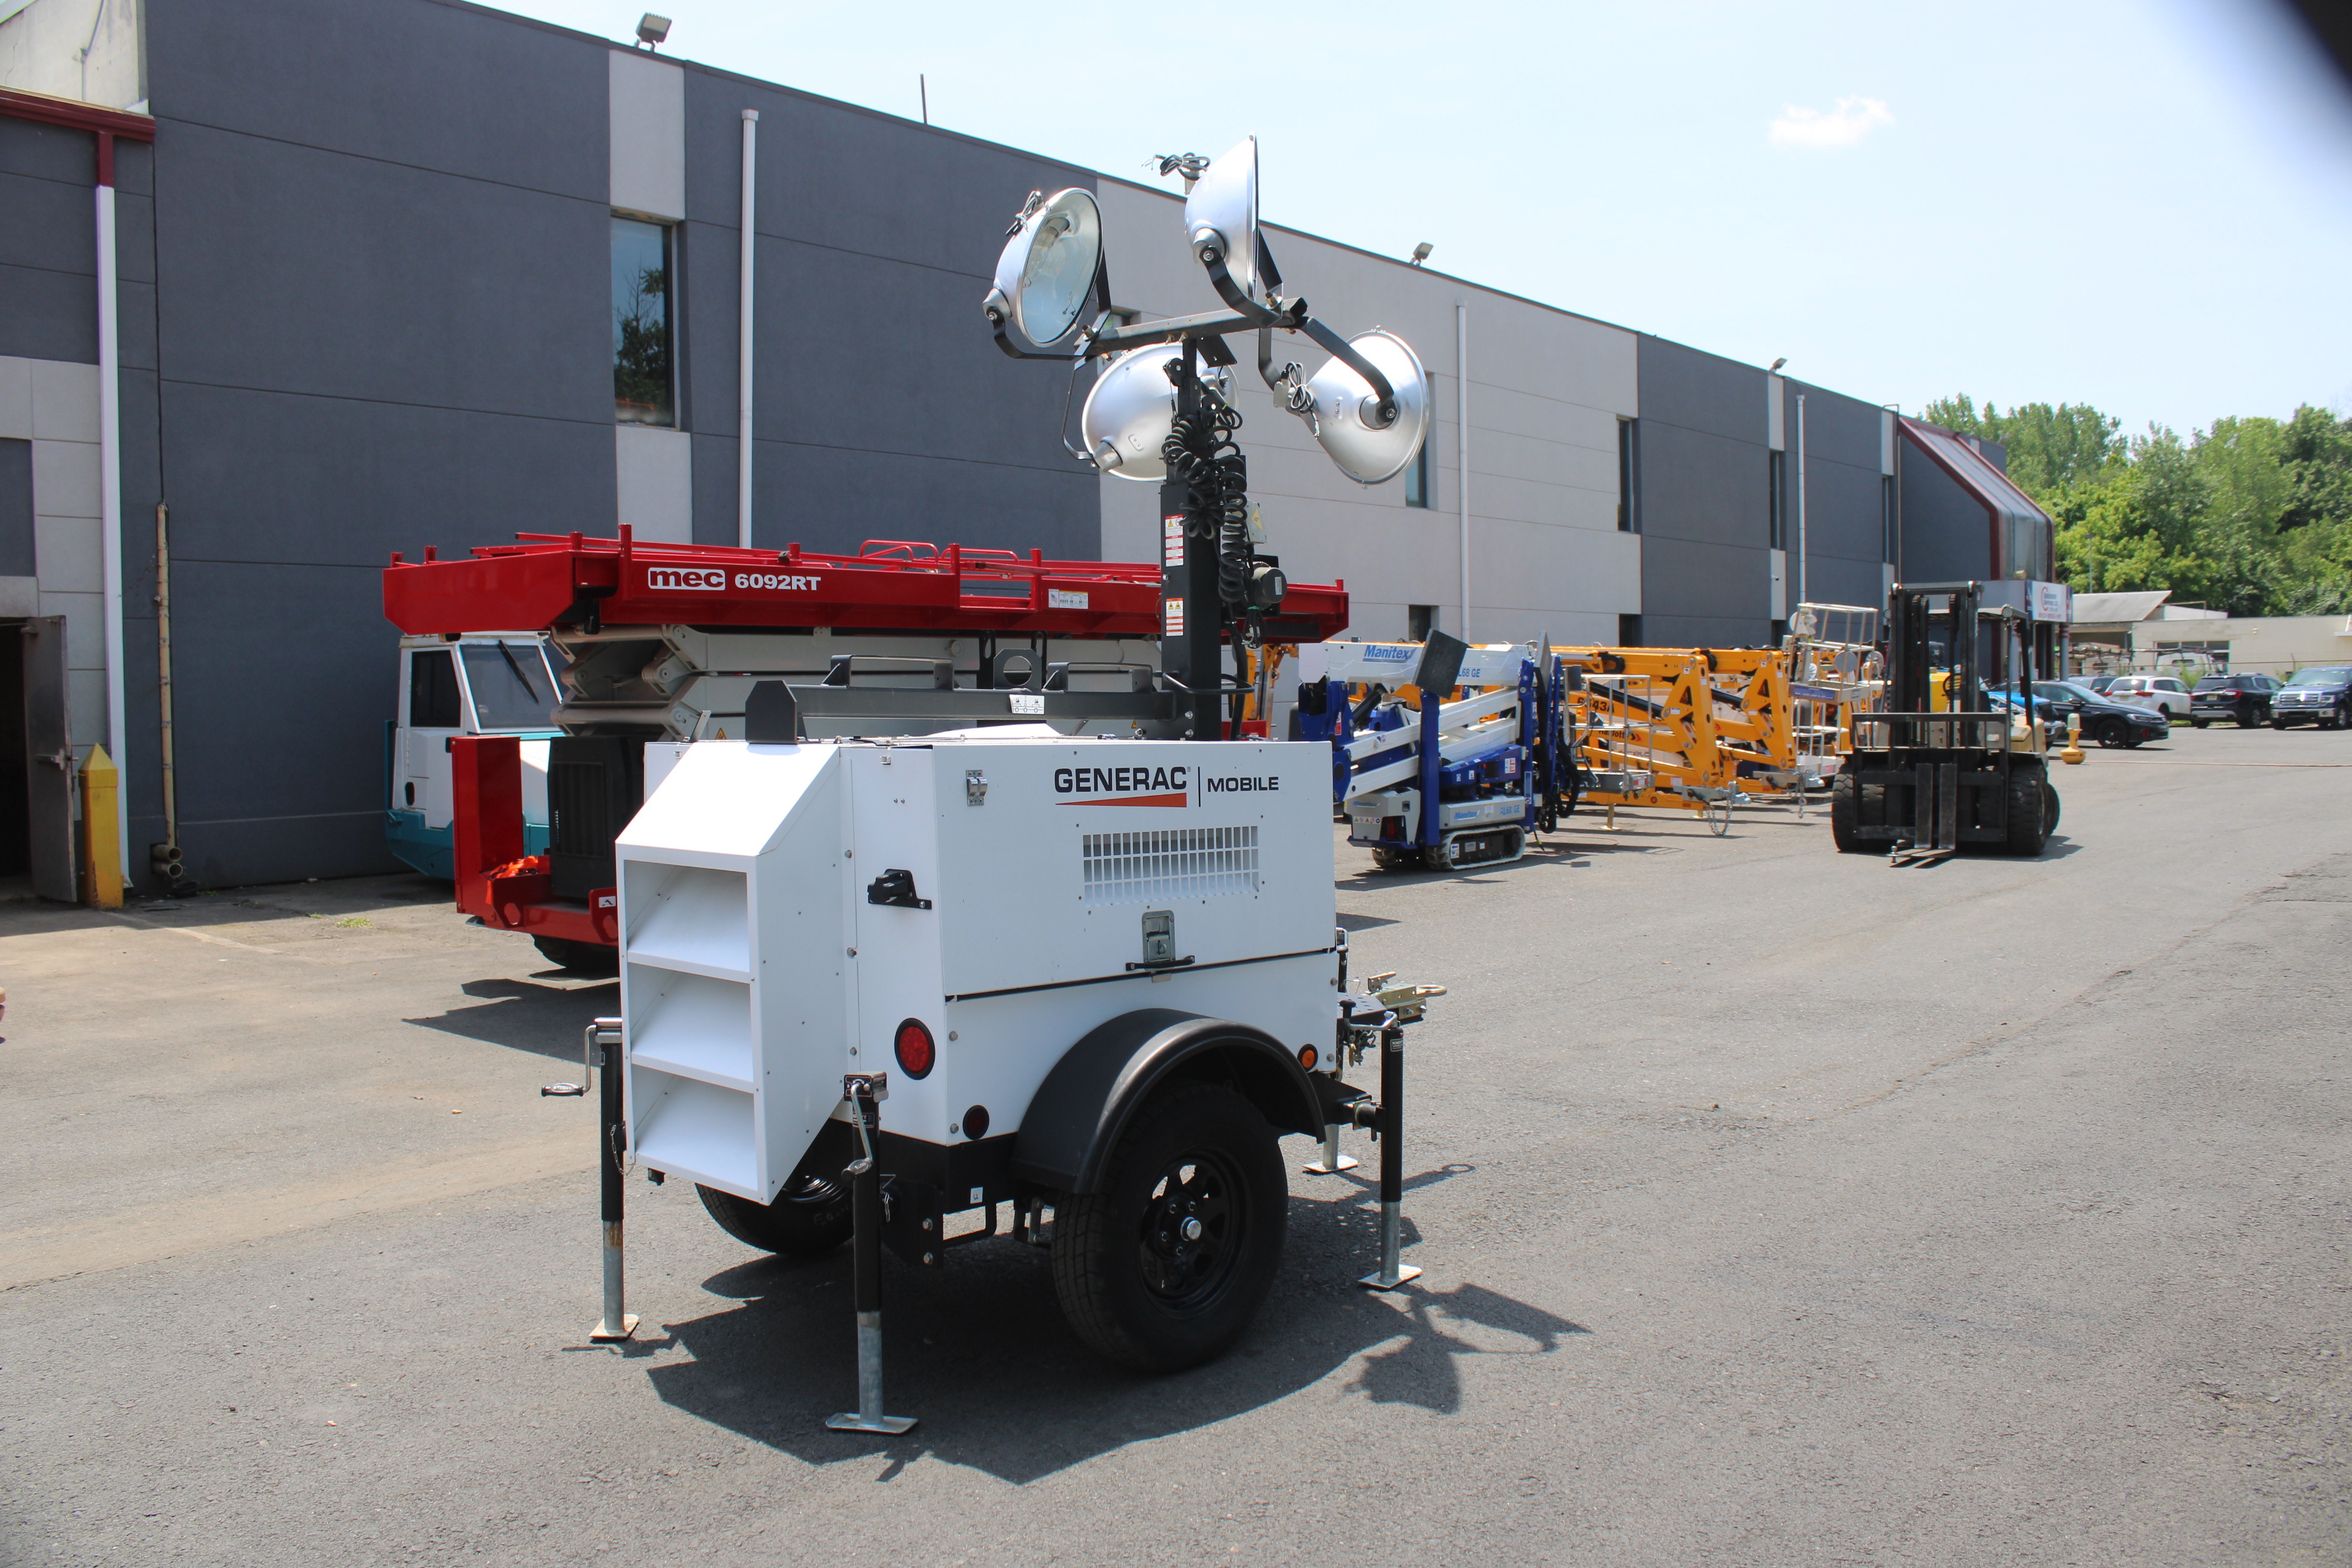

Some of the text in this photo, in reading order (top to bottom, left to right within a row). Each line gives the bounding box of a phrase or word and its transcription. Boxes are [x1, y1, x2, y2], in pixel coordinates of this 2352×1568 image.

[650, 570, 821, 590] mec 6092RT
[1364, 645, 1410, 659] Manitex
[1471, 668, 1481, 678] GE
[1054, 766, 1279, 792] GENERAC MOBILE
[1455, 811, 1478, 819] Manitex
